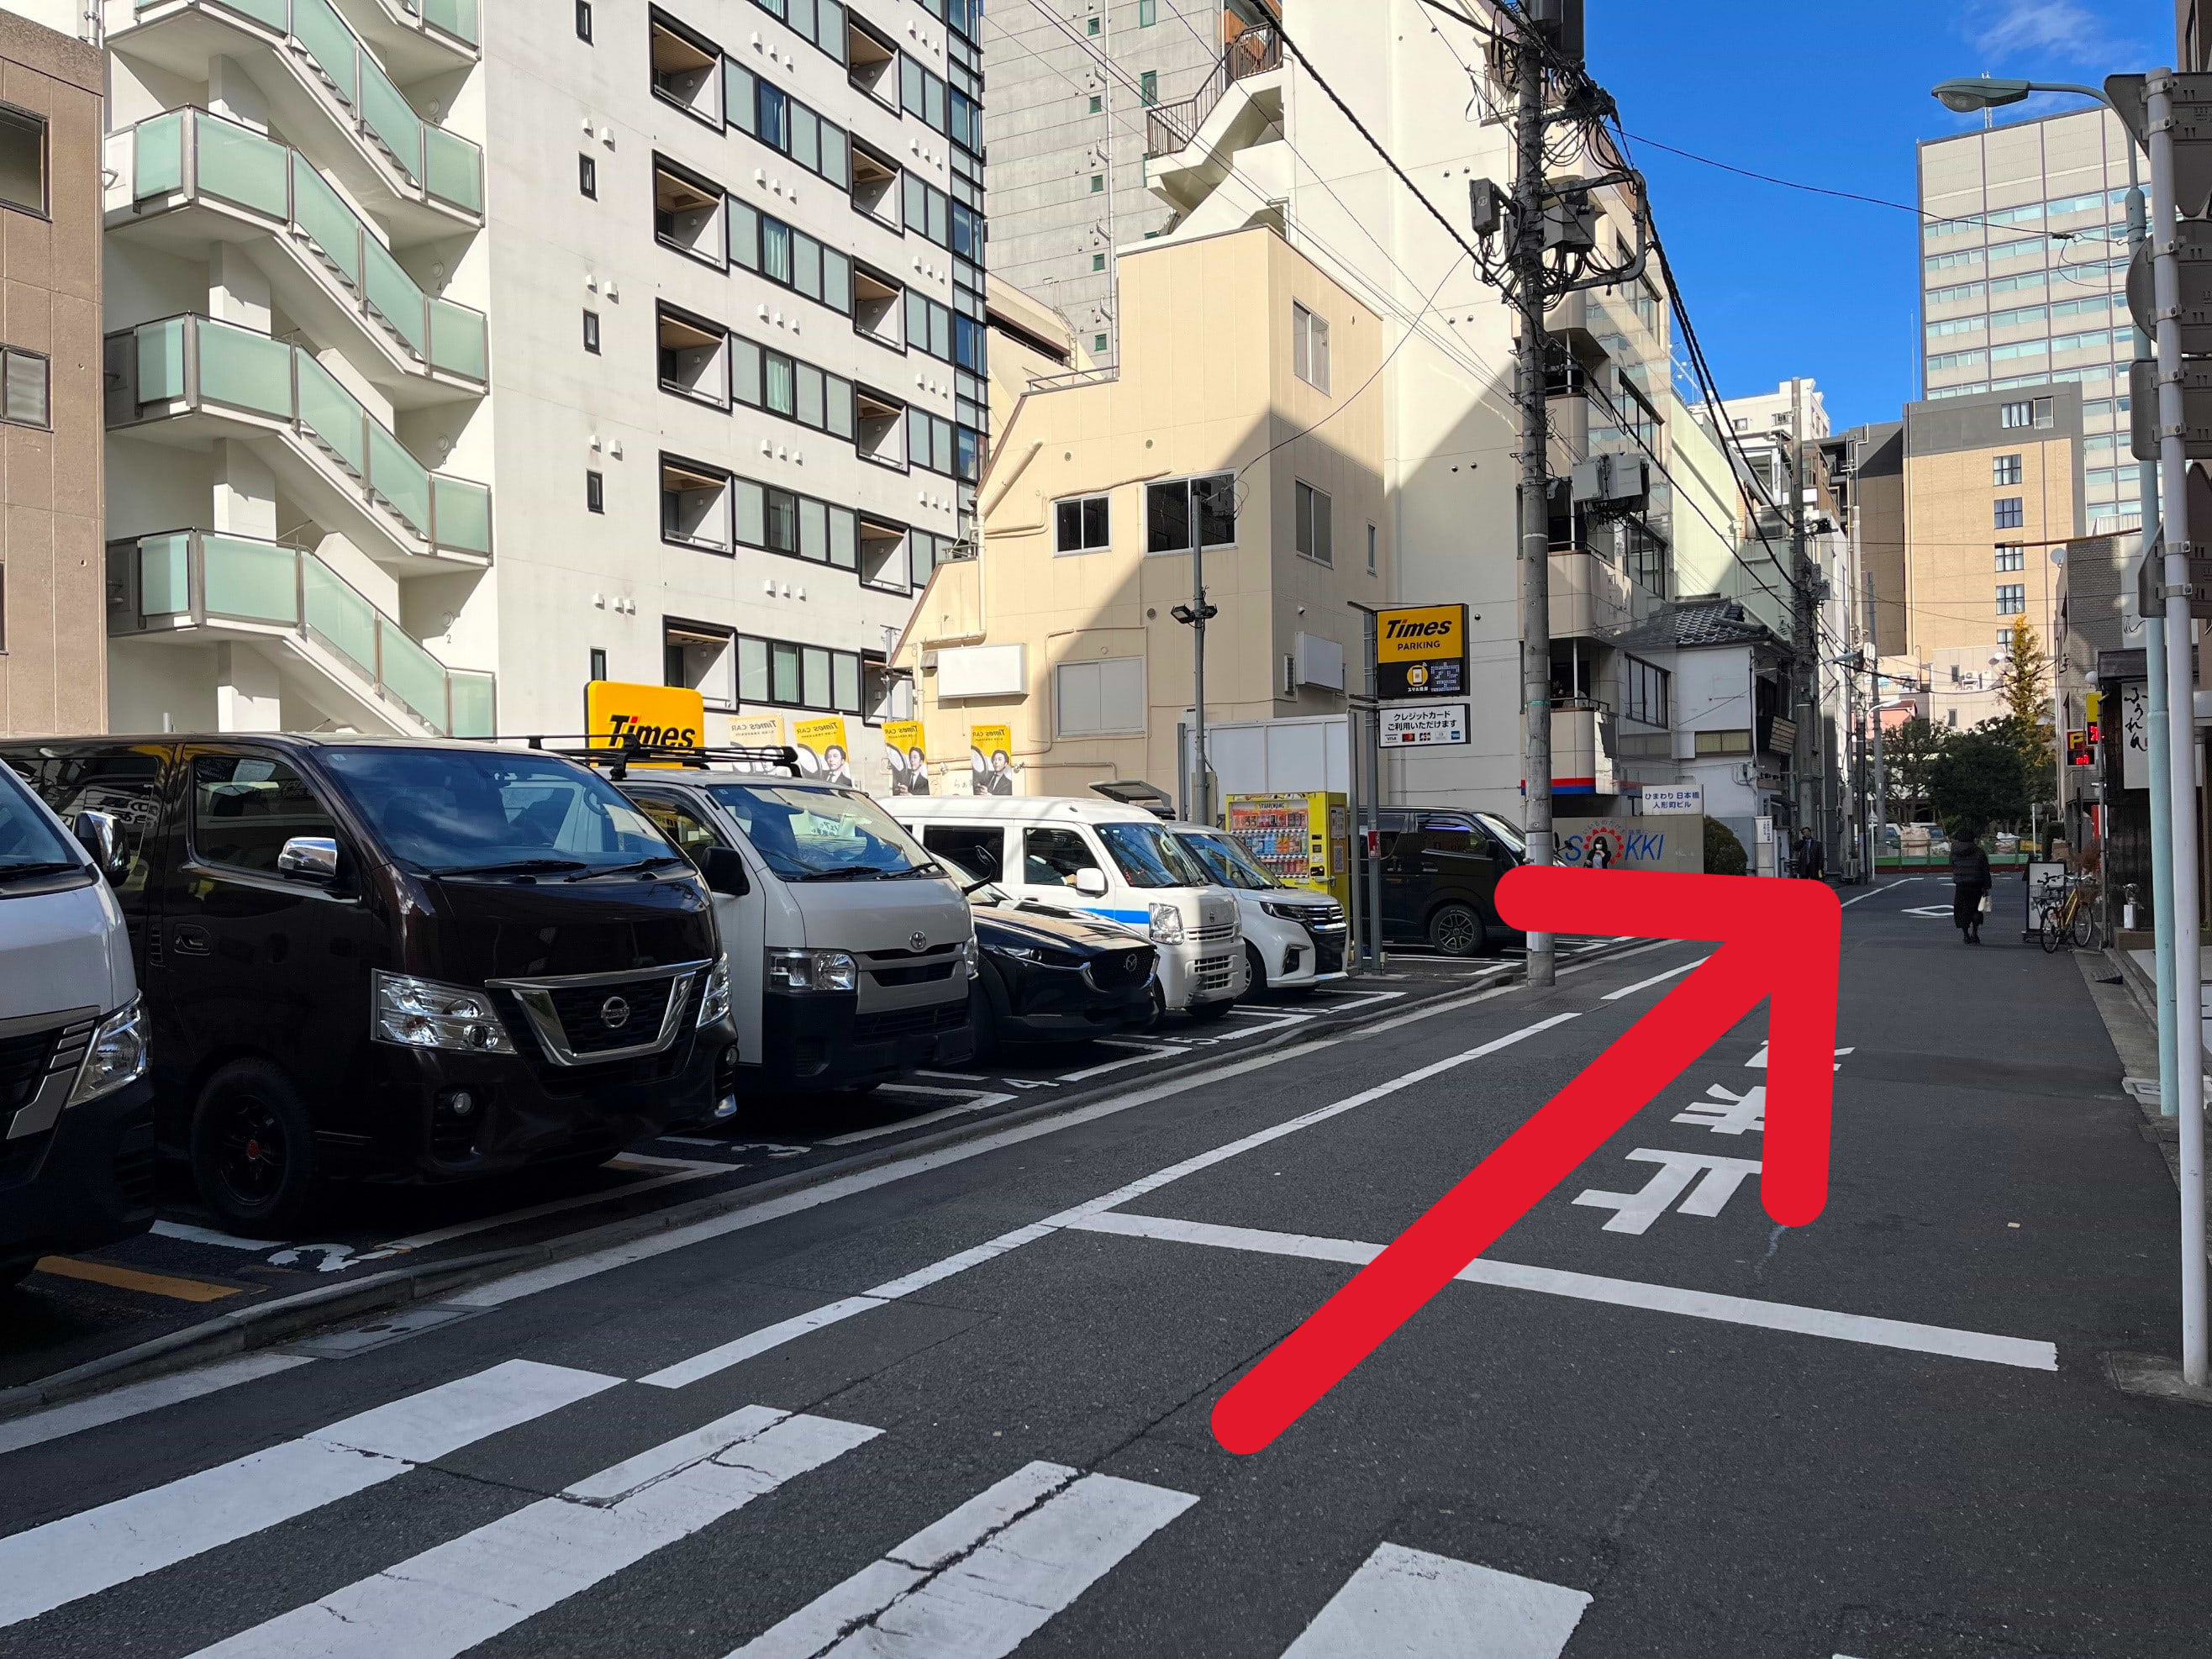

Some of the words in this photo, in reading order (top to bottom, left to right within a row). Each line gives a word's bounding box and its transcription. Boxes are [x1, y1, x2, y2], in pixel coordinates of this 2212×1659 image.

[1386, 619, 1453, 639] Times
[446, 634, 451, 645] 2
[1397, 640, 1440, 650] PARKING
[1430, 661, 1461, 693] 空
[1393, 710, 1451, 721] クレジットカード
[1388, 719, 1457, 731] ご利用いただけます
[608, 714, 696, 748] Times
[1677, 791, 1699, 799] 日本橋
